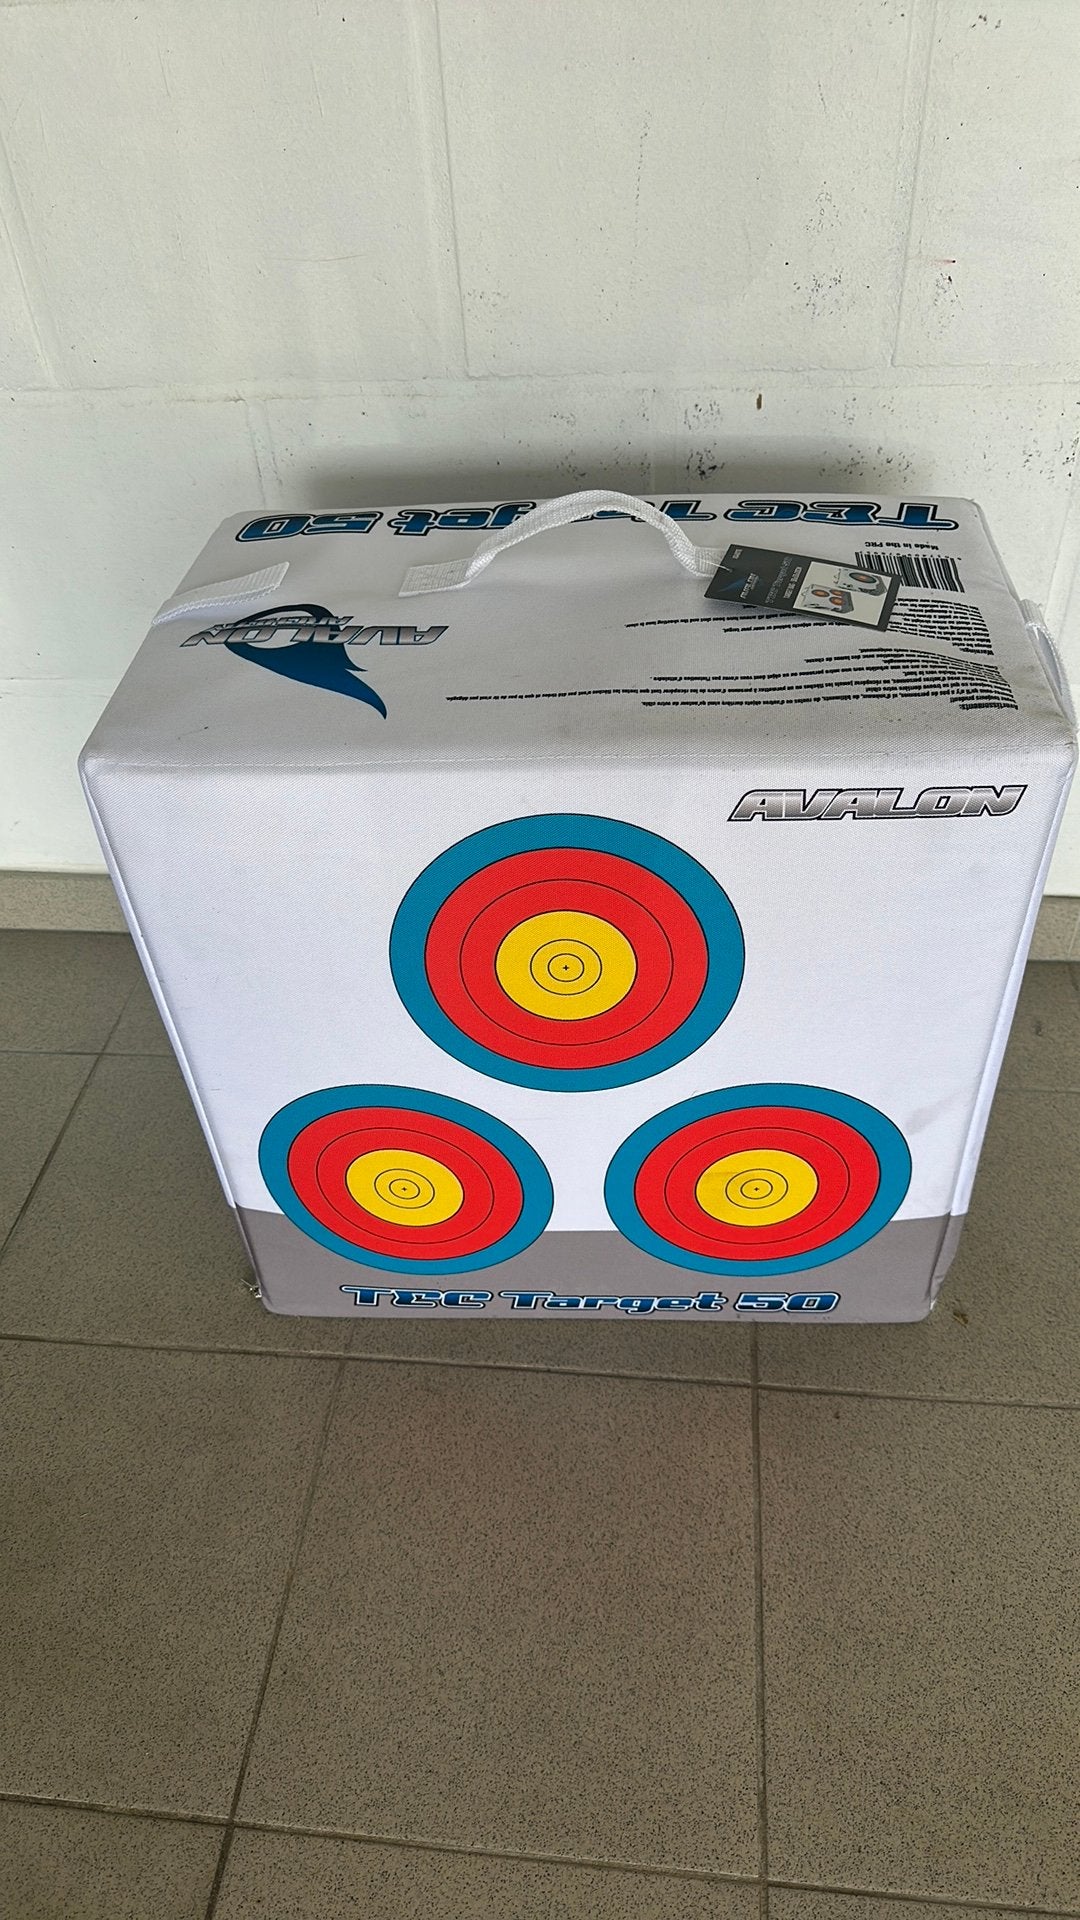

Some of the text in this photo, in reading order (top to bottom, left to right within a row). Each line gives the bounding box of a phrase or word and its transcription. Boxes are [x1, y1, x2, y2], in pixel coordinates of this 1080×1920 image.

[236, 500, 958, 542] TEC Tget 50
[179, 625, 449, 647] AVALON
[727, 785, 1028, 821] AVALON
[340, 1285, 841, 1315] TEC Target 50
